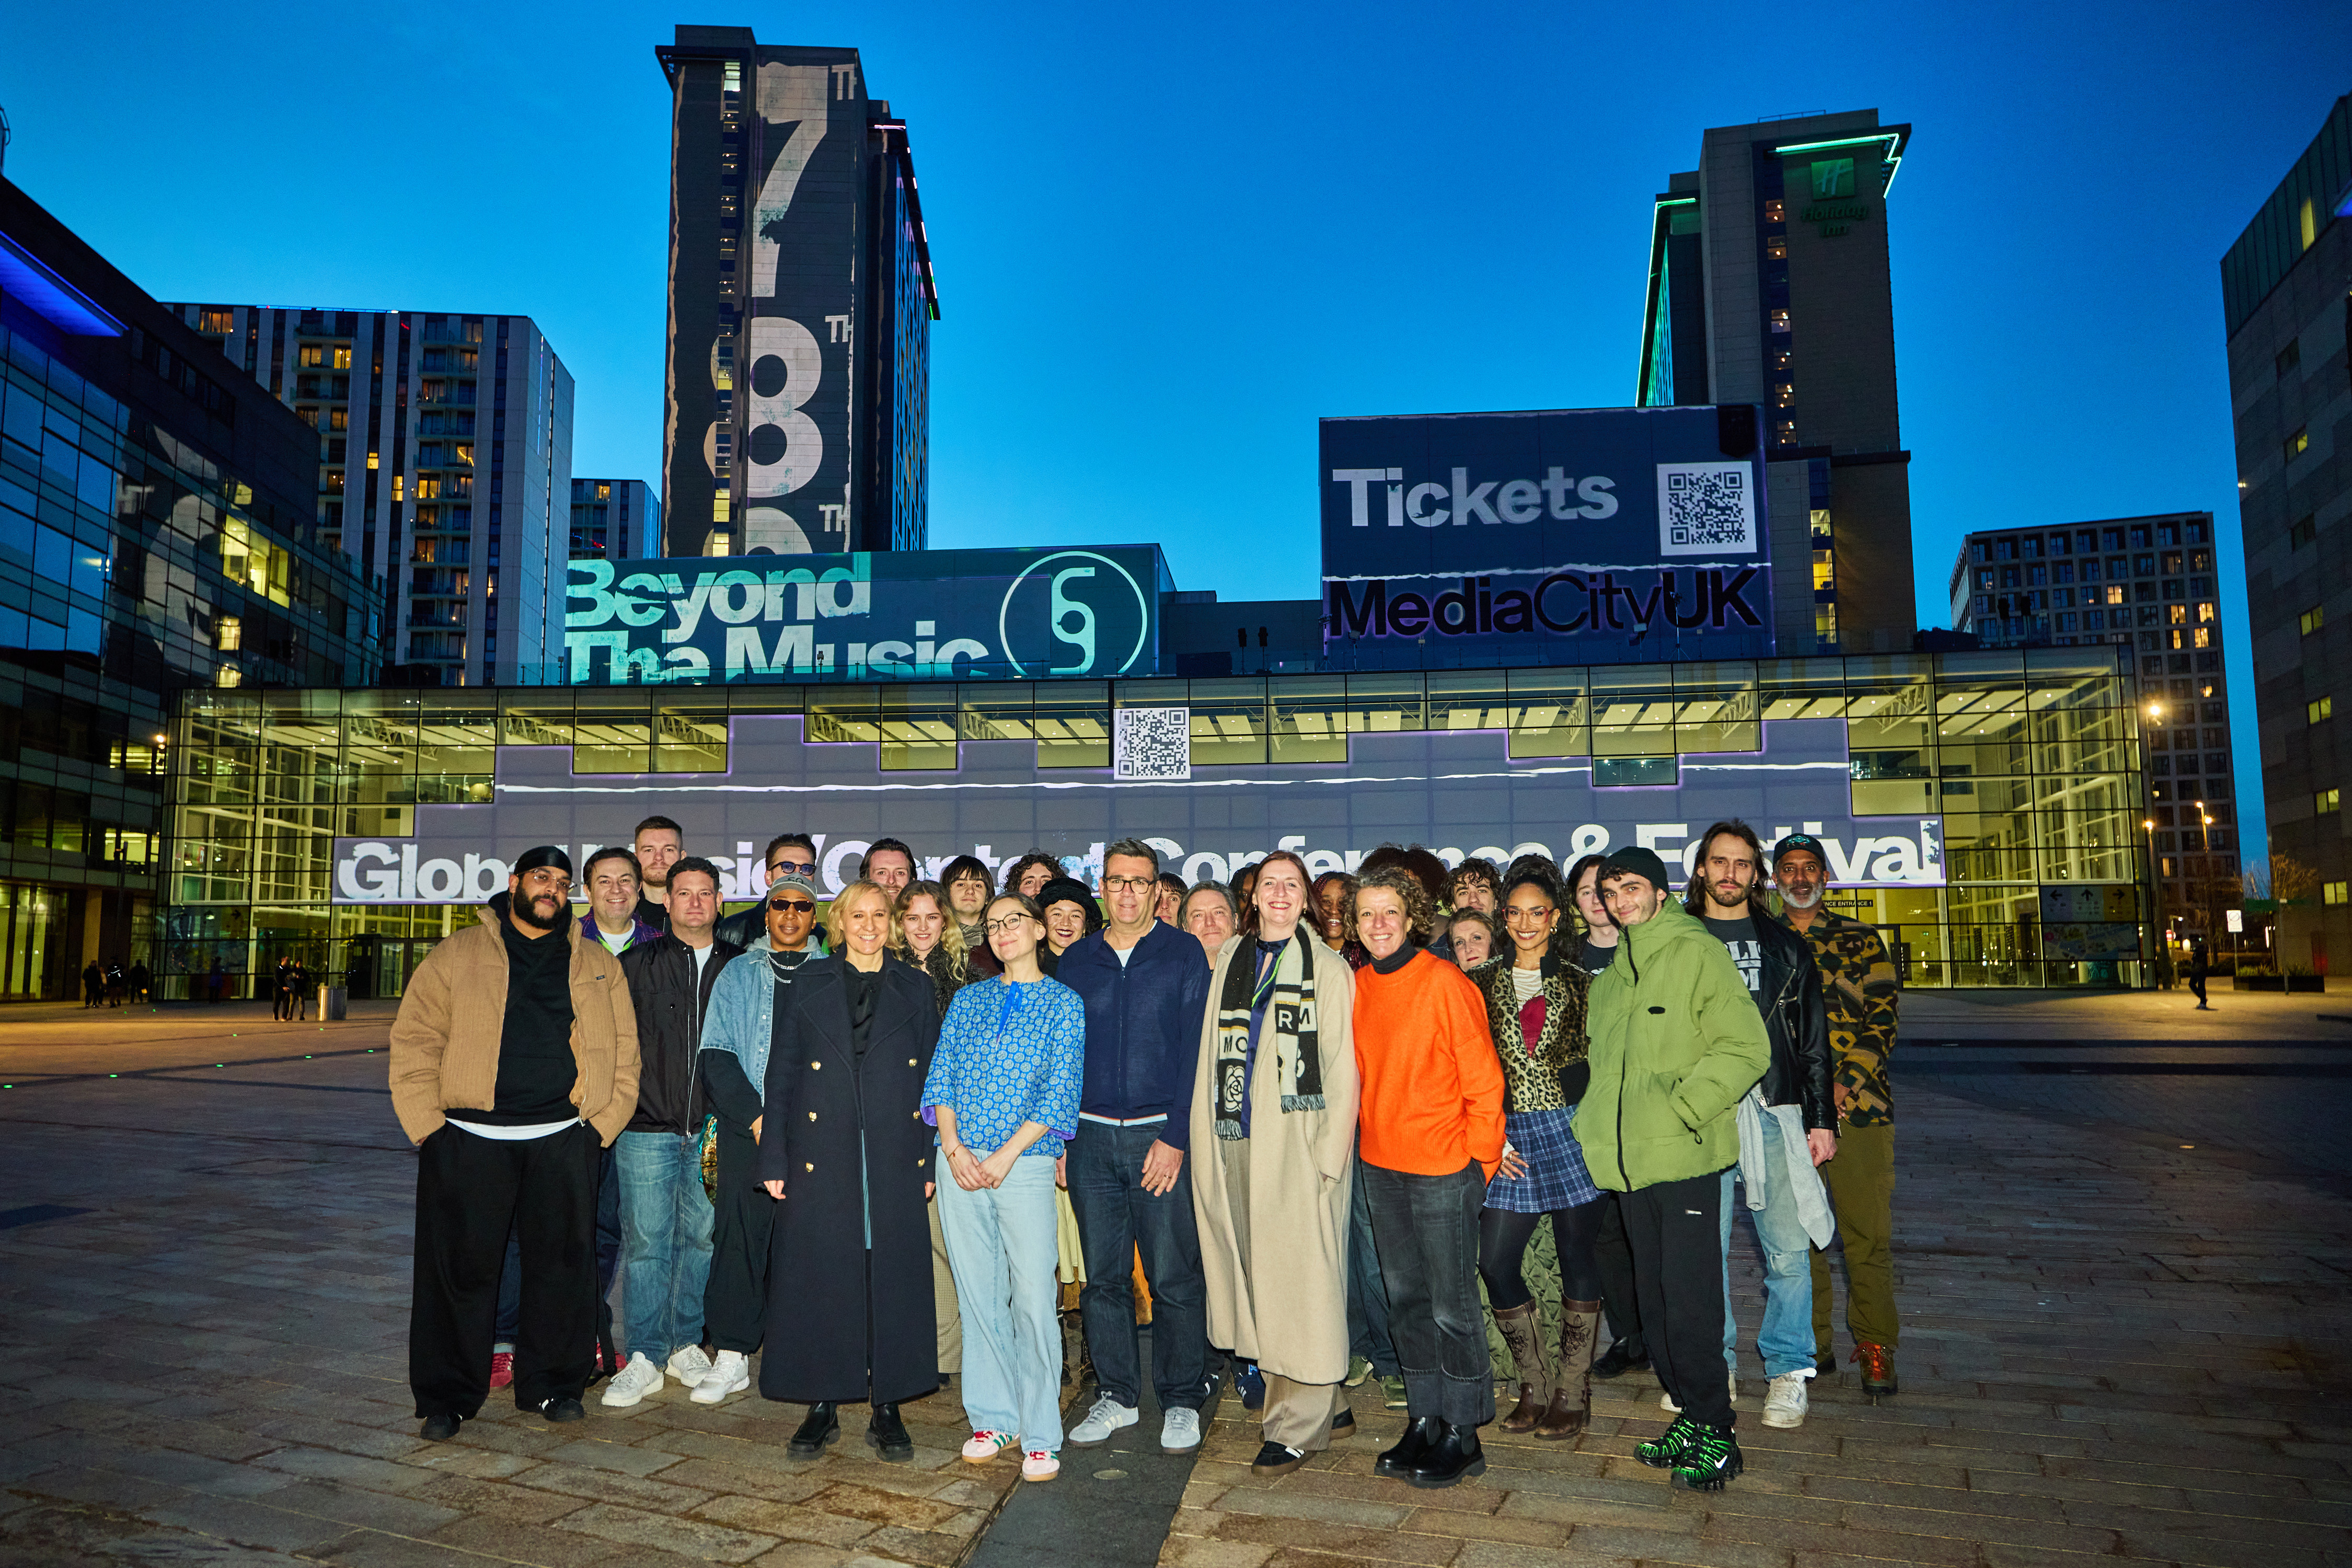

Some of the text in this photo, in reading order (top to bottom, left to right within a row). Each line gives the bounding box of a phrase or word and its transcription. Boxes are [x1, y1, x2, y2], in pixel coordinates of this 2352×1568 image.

[1333, 466, 1619, 526] Tickets
[565, 551, 871, 643] Beyond
[1331, 569, 1762, 637] MediaCityUK
[726, 620, 989, 684] Music
[338, 841, 568, 898] Glob
[1563, 824, 1609, 879] &
